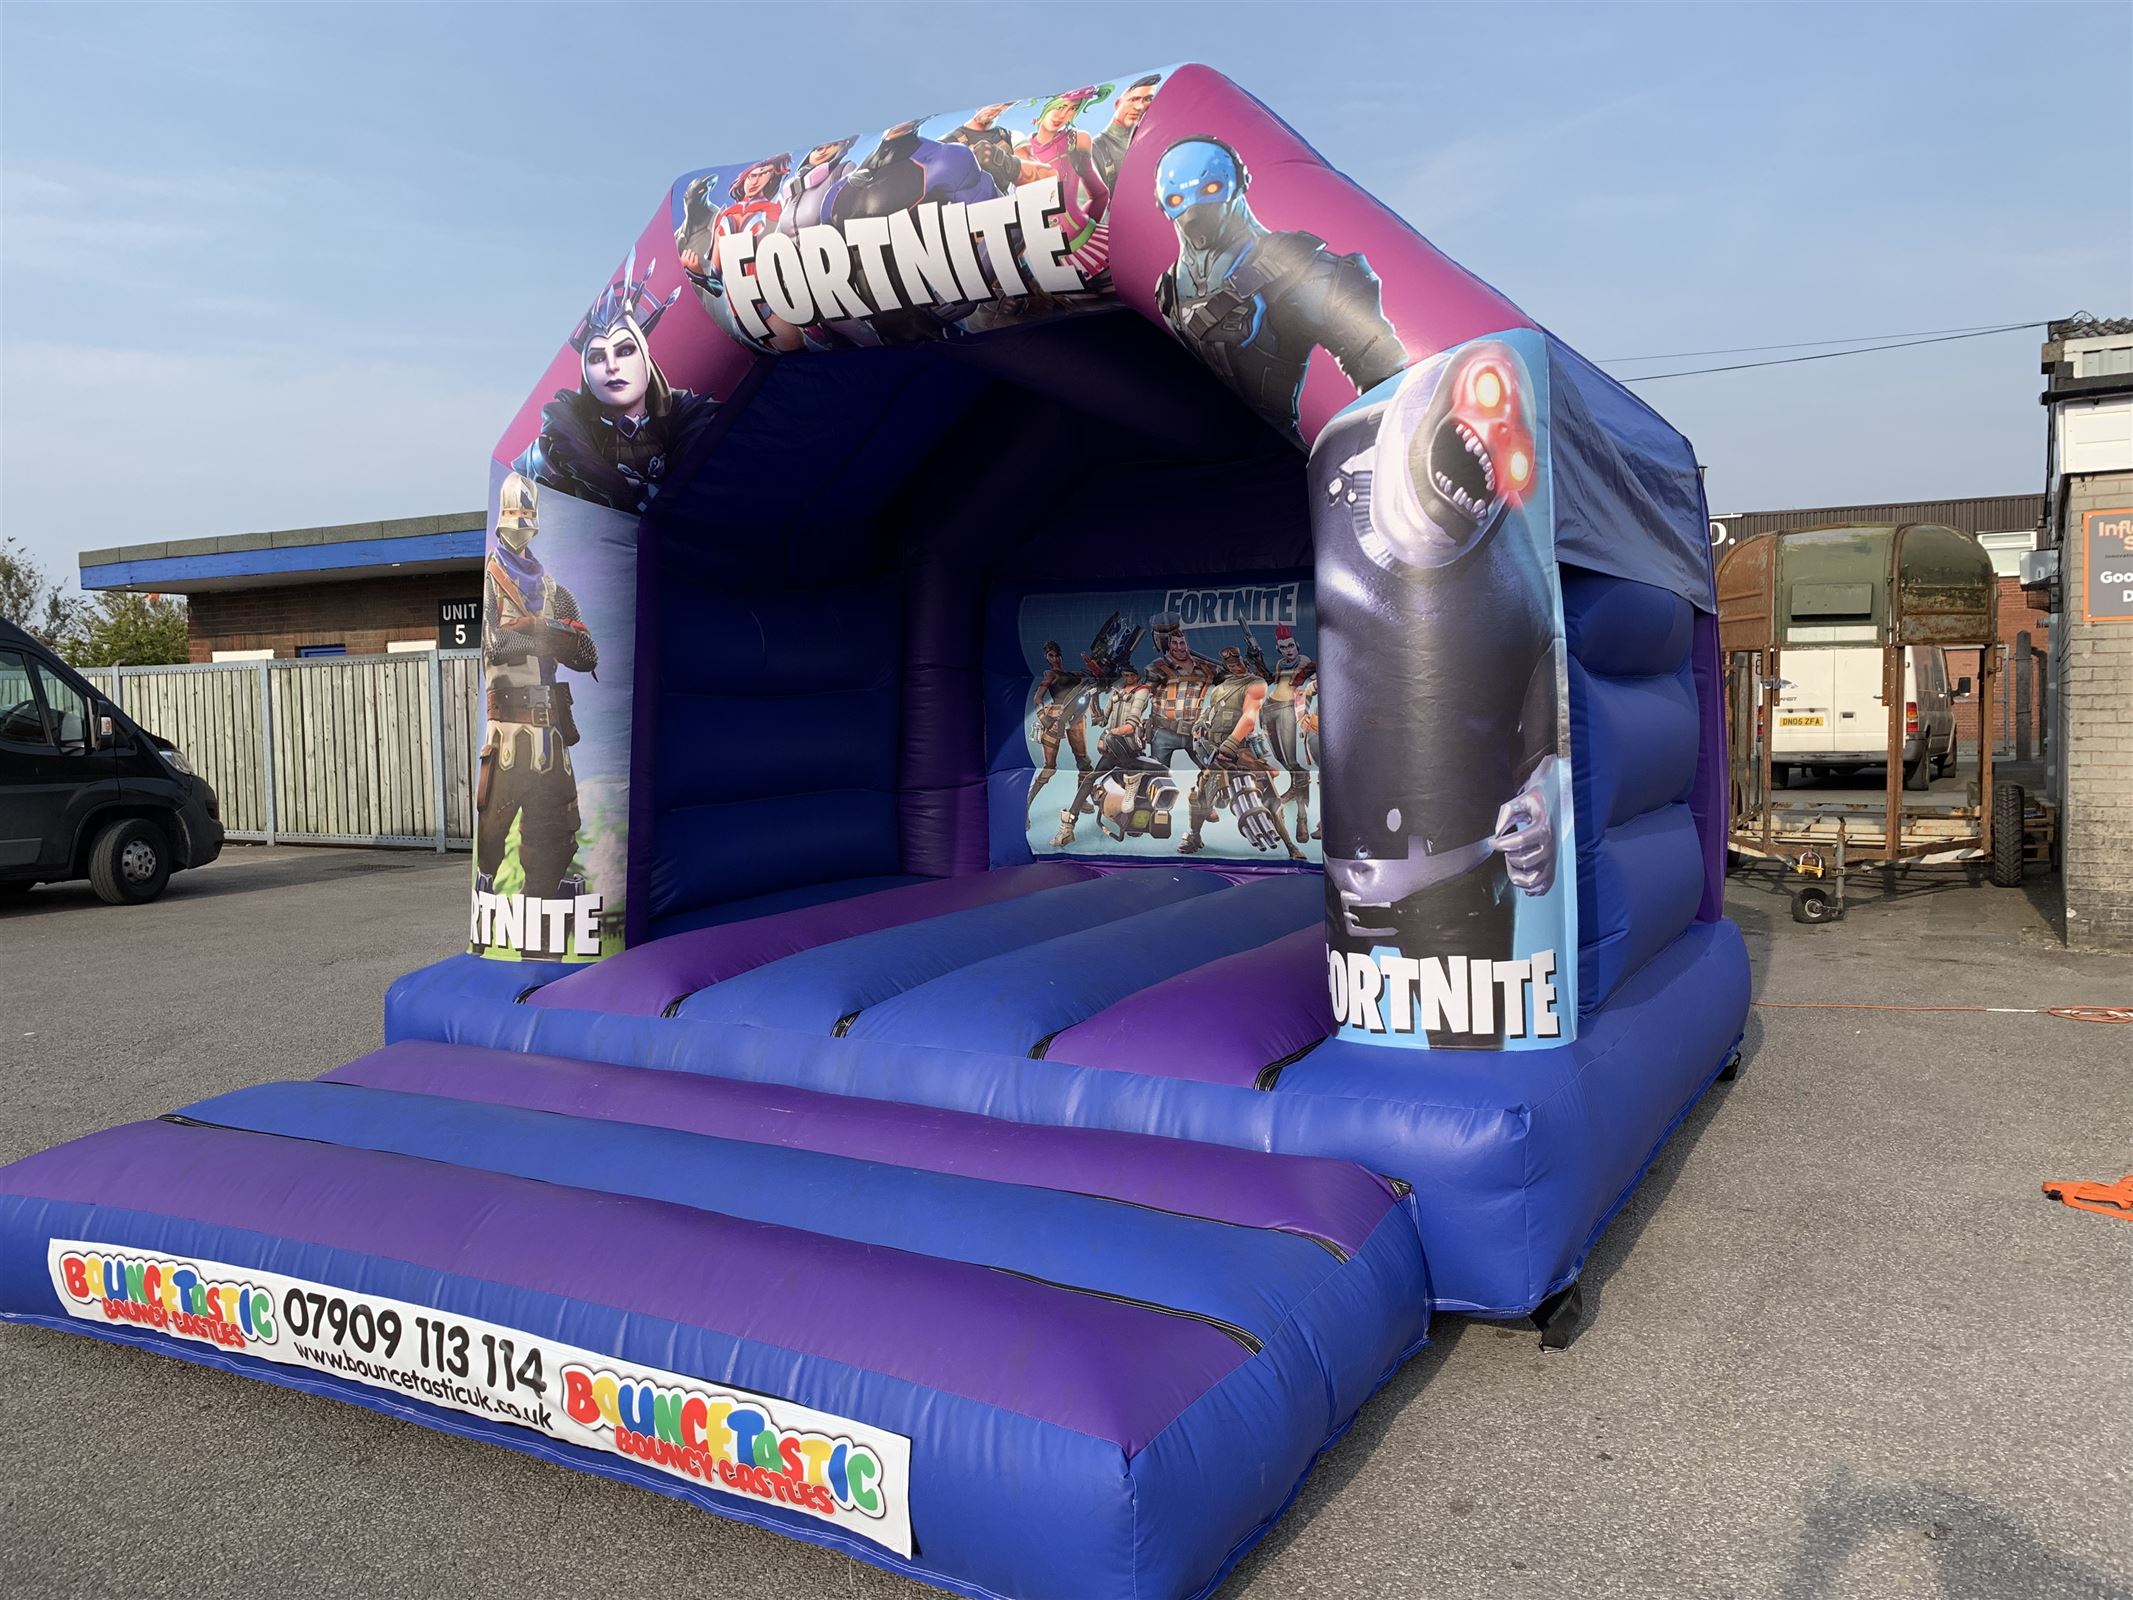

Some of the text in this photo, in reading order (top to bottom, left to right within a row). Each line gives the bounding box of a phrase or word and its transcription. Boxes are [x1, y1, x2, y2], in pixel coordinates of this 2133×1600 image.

[719, 175, 1086, 340] FORTNITE
[2098, 519, 2133, 539] Infl
[442, 603, 478, 621] UNIT
[455, 624, 467, 645] 5
[1166, 584, 1298, 626] FORTNITE
[1782, 716, 1820, 726] DN05 ZFA
[1326, 943, 1560, 1038] ORTNITE
[63, 1256, 274, 1339] BOUNCETASTIC
[101, 1296, 246, 1349] BOUNCY CASTLES
[283, 1287, 548, 1399] 07909 113 114
[293, 1341, 554, 1431] www.bouncetasticuk.co.uk
[565, 1371, 879, 1511] BOUNCETASTIC
[615, 1424, 835, 1515] BOUNCY CASTLES
